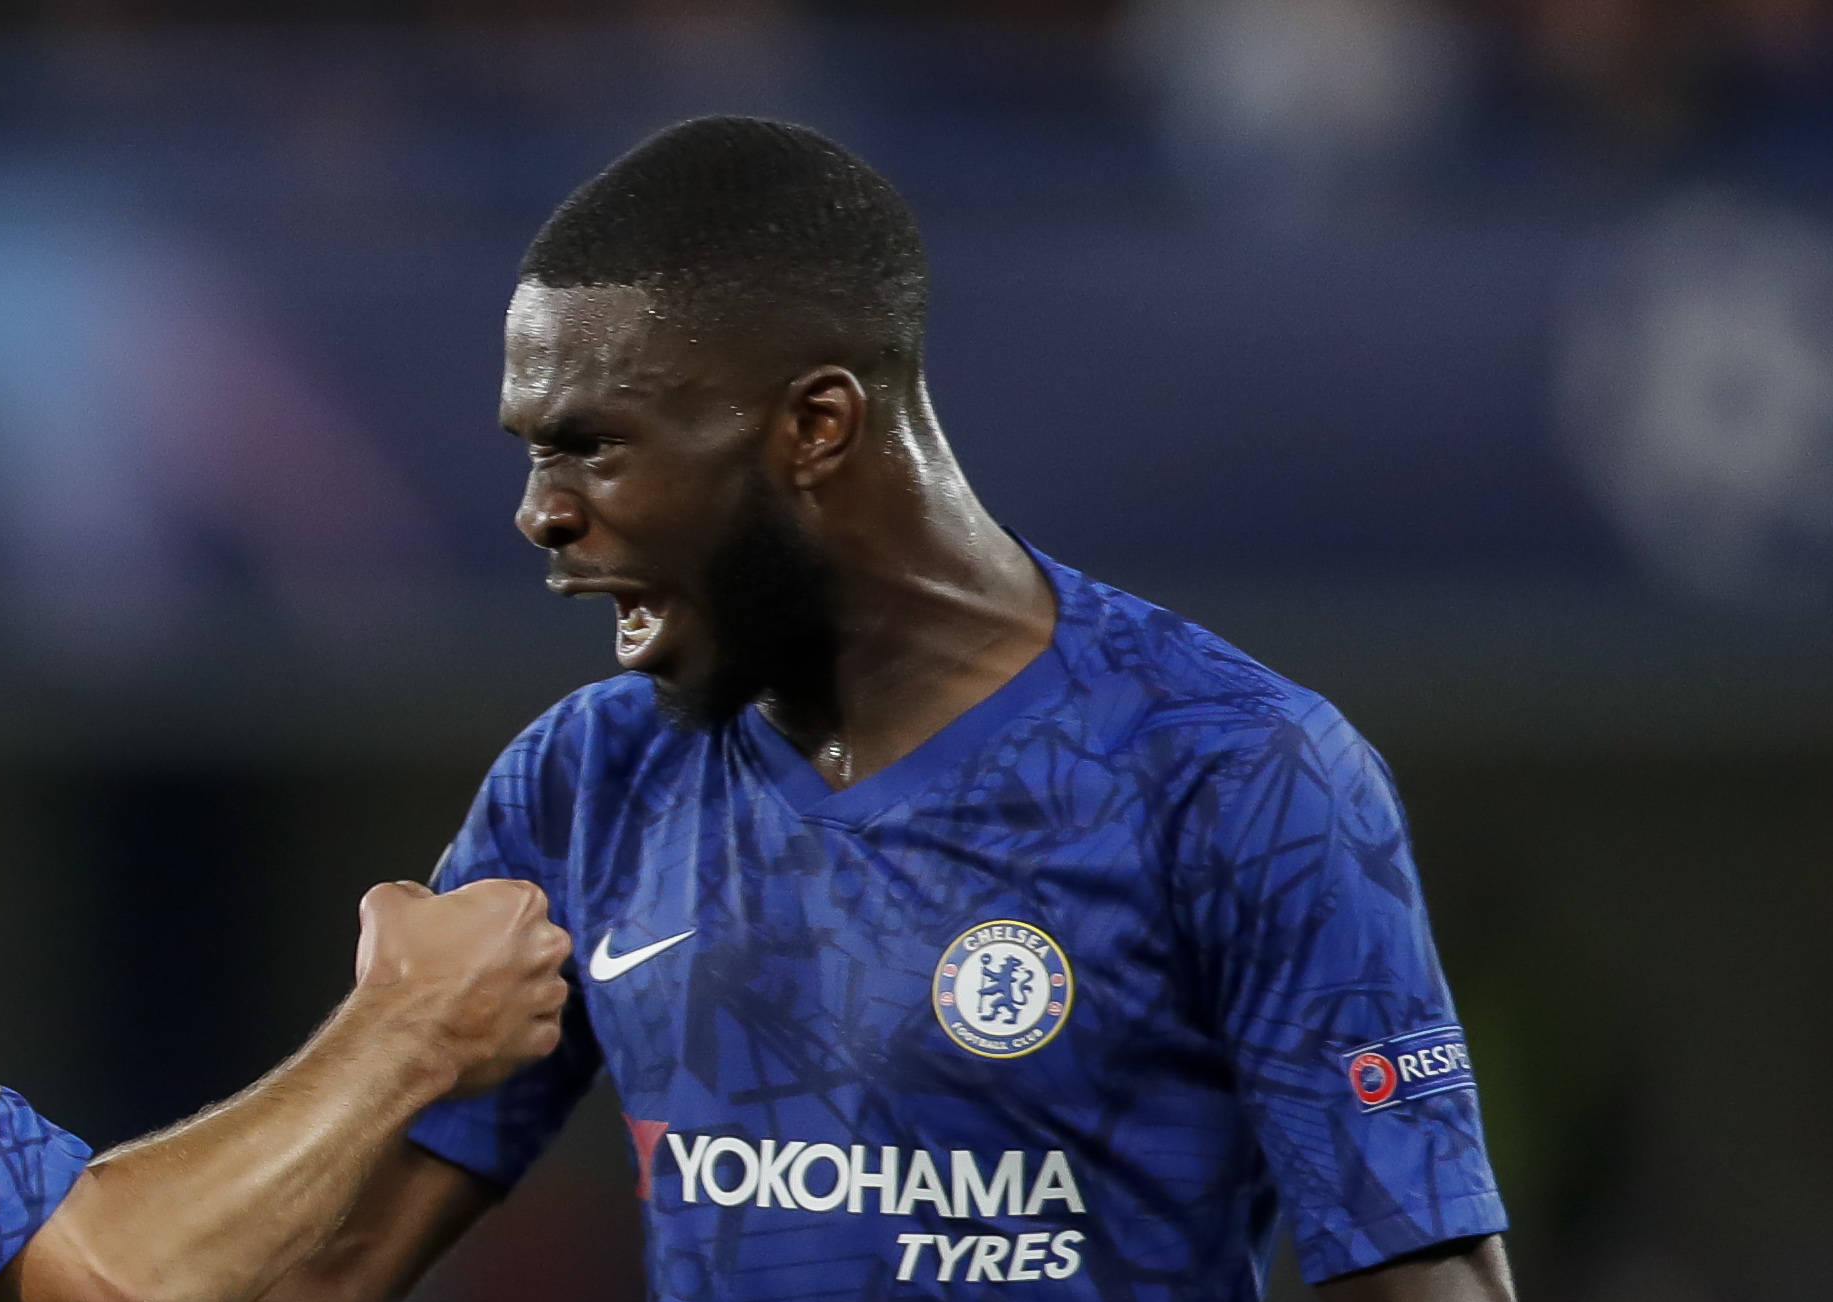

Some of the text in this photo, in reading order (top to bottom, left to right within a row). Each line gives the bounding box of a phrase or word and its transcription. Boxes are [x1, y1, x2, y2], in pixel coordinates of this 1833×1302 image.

[963, 926, 1050, 959] CHELSEA
[666, 1133, 1086, 1218] YOKOHAMA
[895, 1231, 1085, 1282] TYRES
